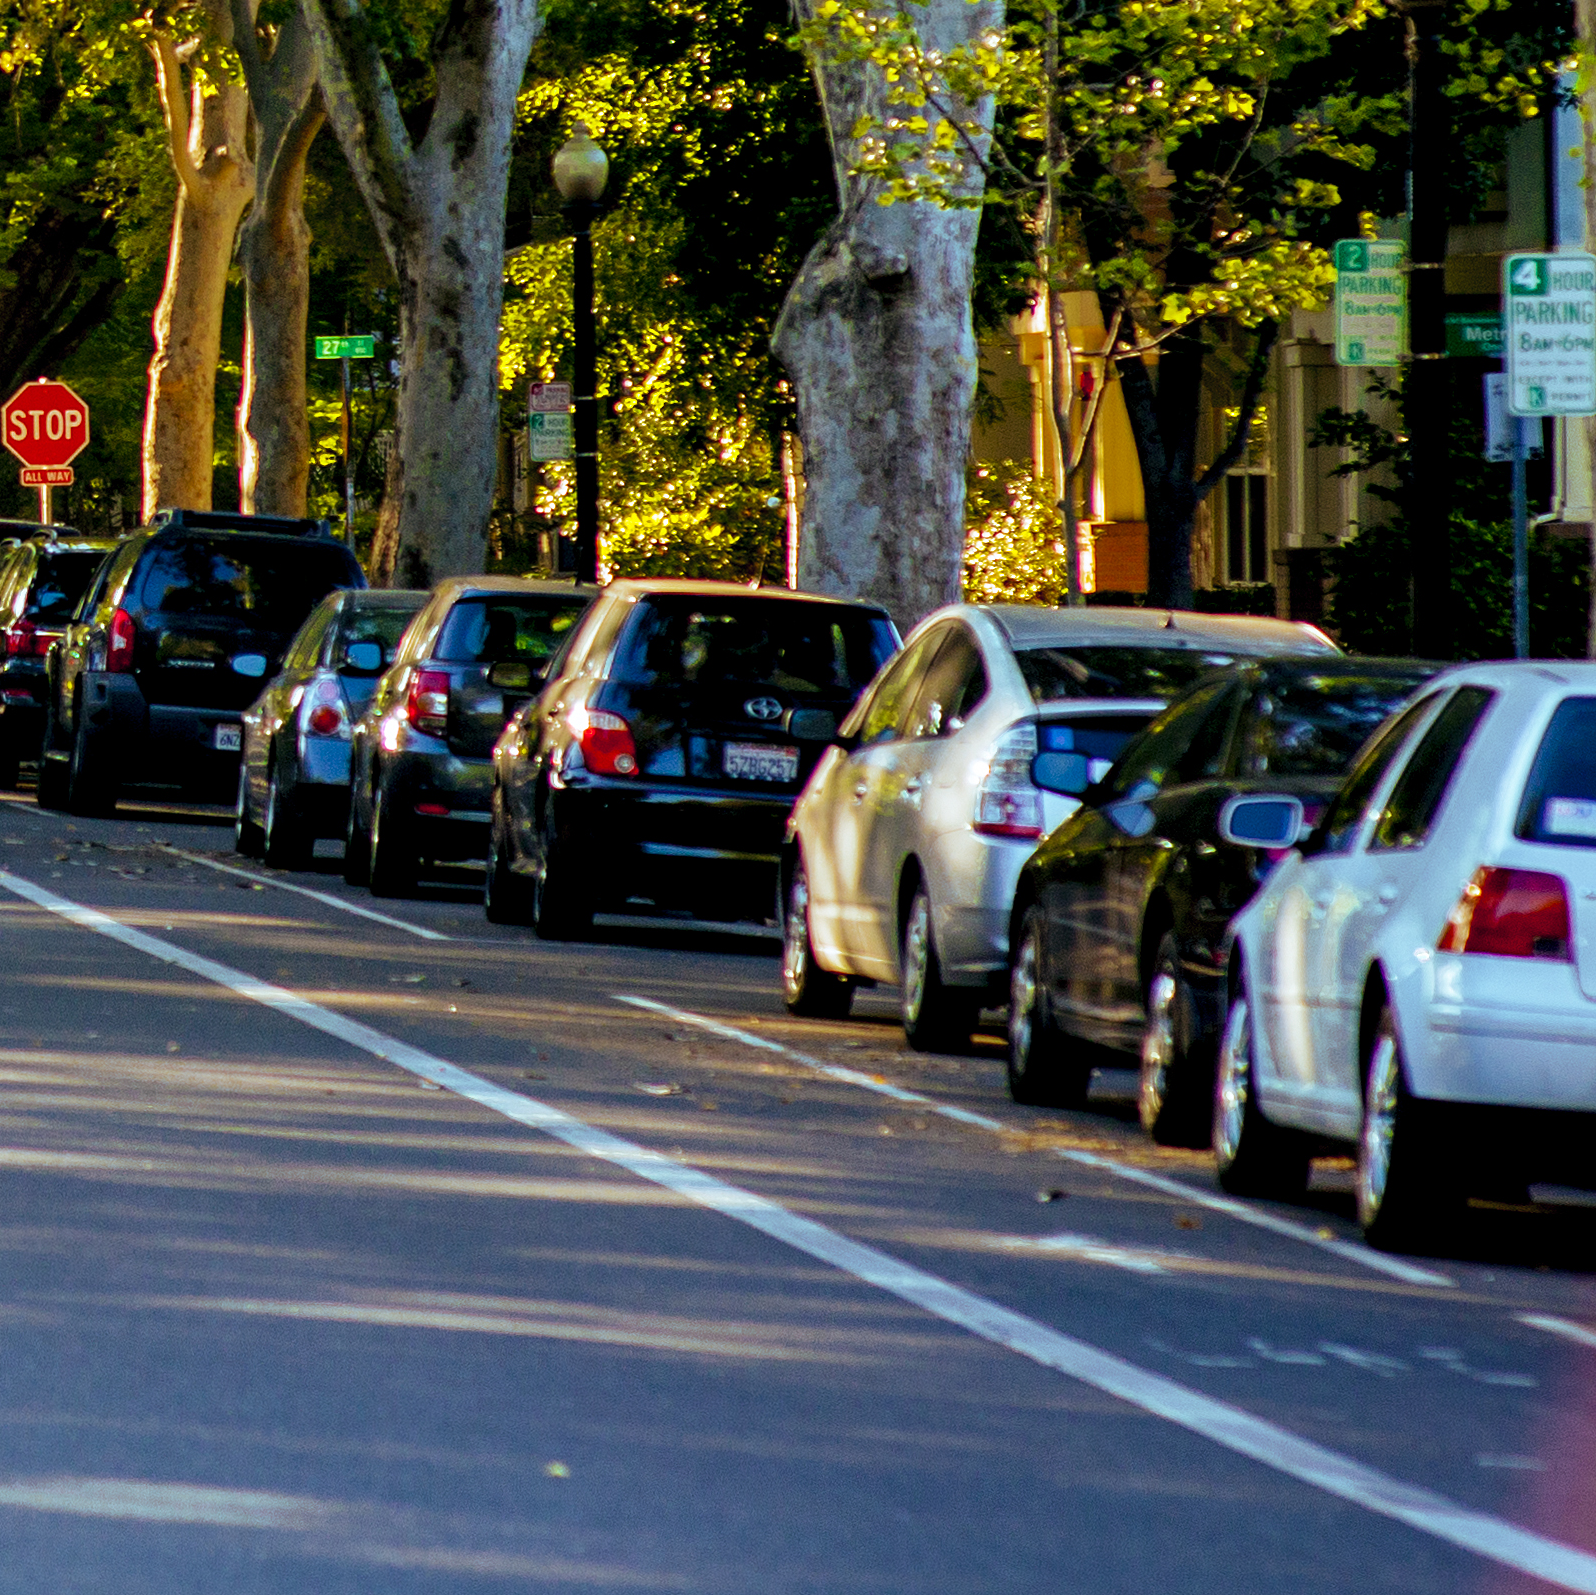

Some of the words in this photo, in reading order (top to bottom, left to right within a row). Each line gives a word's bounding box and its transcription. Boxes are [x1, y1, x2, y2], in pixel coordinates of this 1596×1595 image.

[1348, 245, 1362, 268] 2
[1338, 276, 1403, 295] PARKING
[1513, 260, 1541, 290] 4
[1552, 271, 1594, 291] HOUR
[1515, 301, 1593, 325] PARKING
[1466, 327, 1507, 341] Metr
[9, 409, 83, 441] STOP
[25, 471, 43, 482] ALL
[46, 471, 71, 482] WAY
